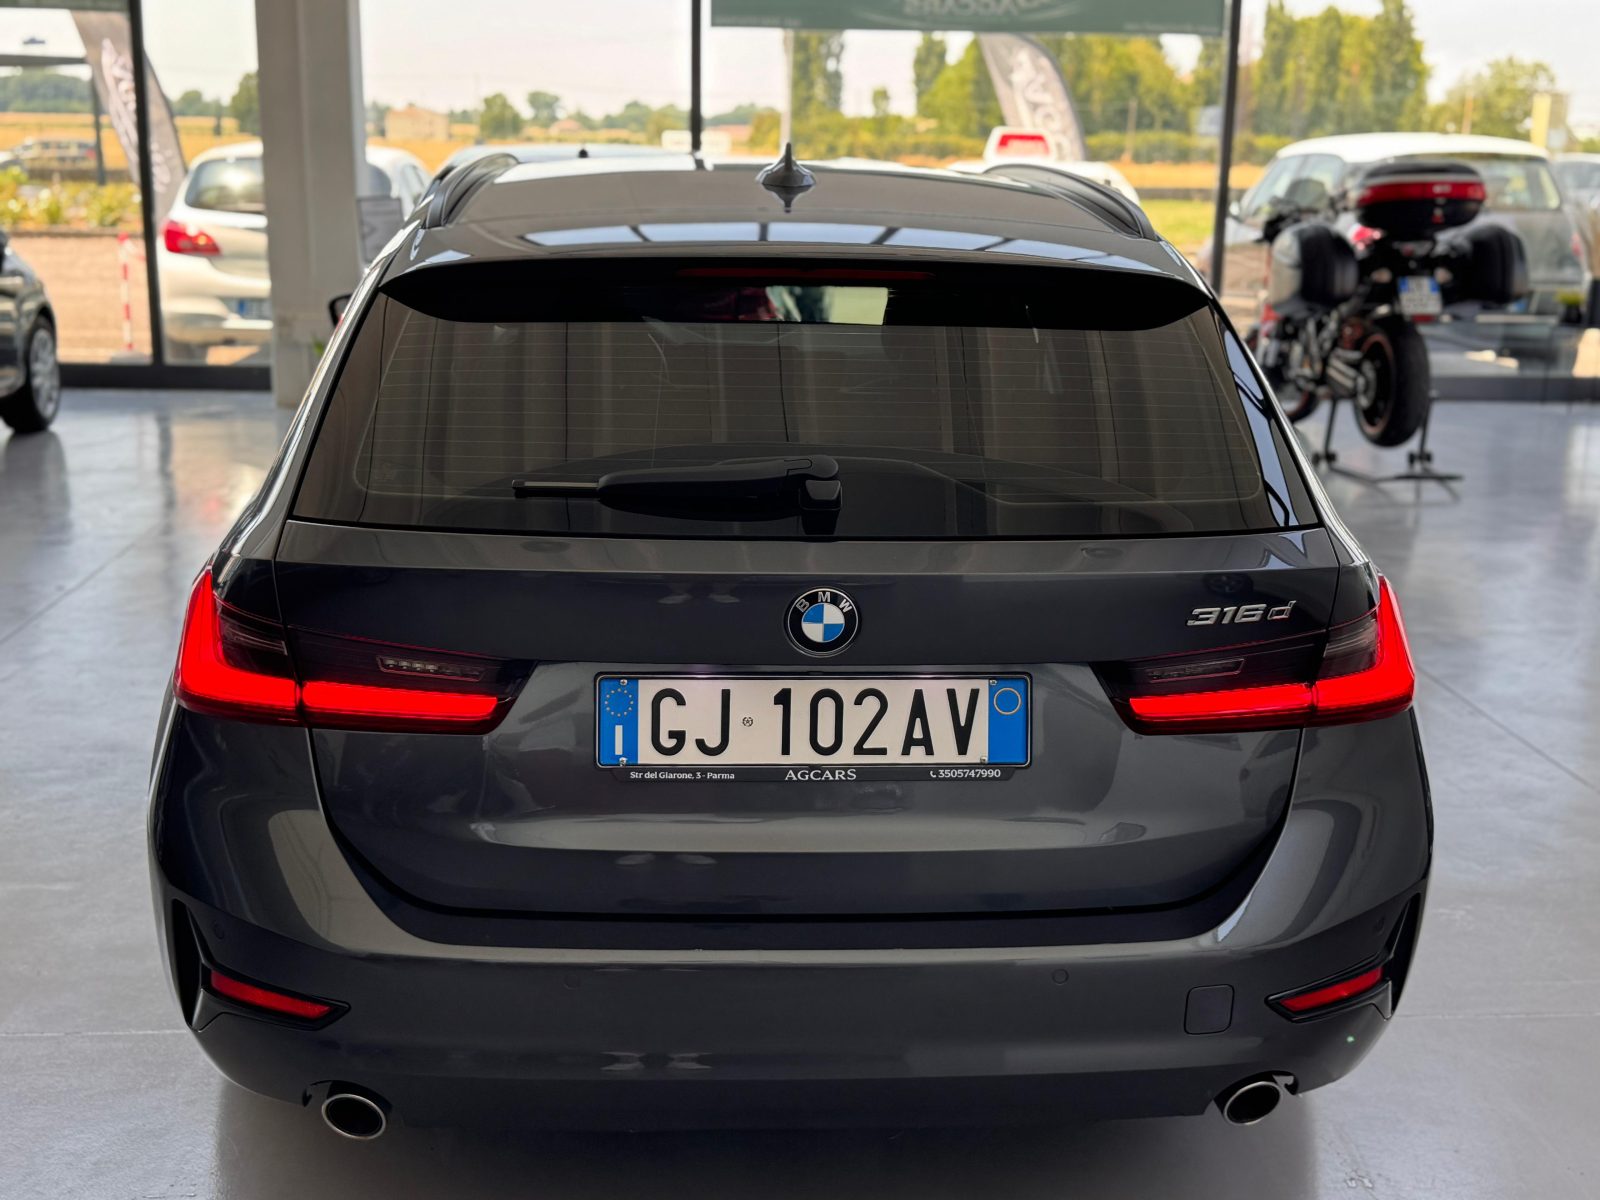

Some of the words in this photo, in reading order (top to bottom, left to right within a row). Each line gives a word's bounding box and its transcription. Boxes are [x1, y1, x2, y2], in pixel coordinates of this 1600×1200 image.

[795, 591, 853, 613] BMW
[1186, 600, 1297, 626] 316d
[650, 687, 731, 757] GJ
[773, 687, 980, 757] 102AV
[629, 771, 643, 779] Str
[644, 771, 657, 779] del
[706, 772, 735, 780] Parma
[784, 768, 857, 781] AGCARS
[938, 769, 1001, 778] 3505747990
